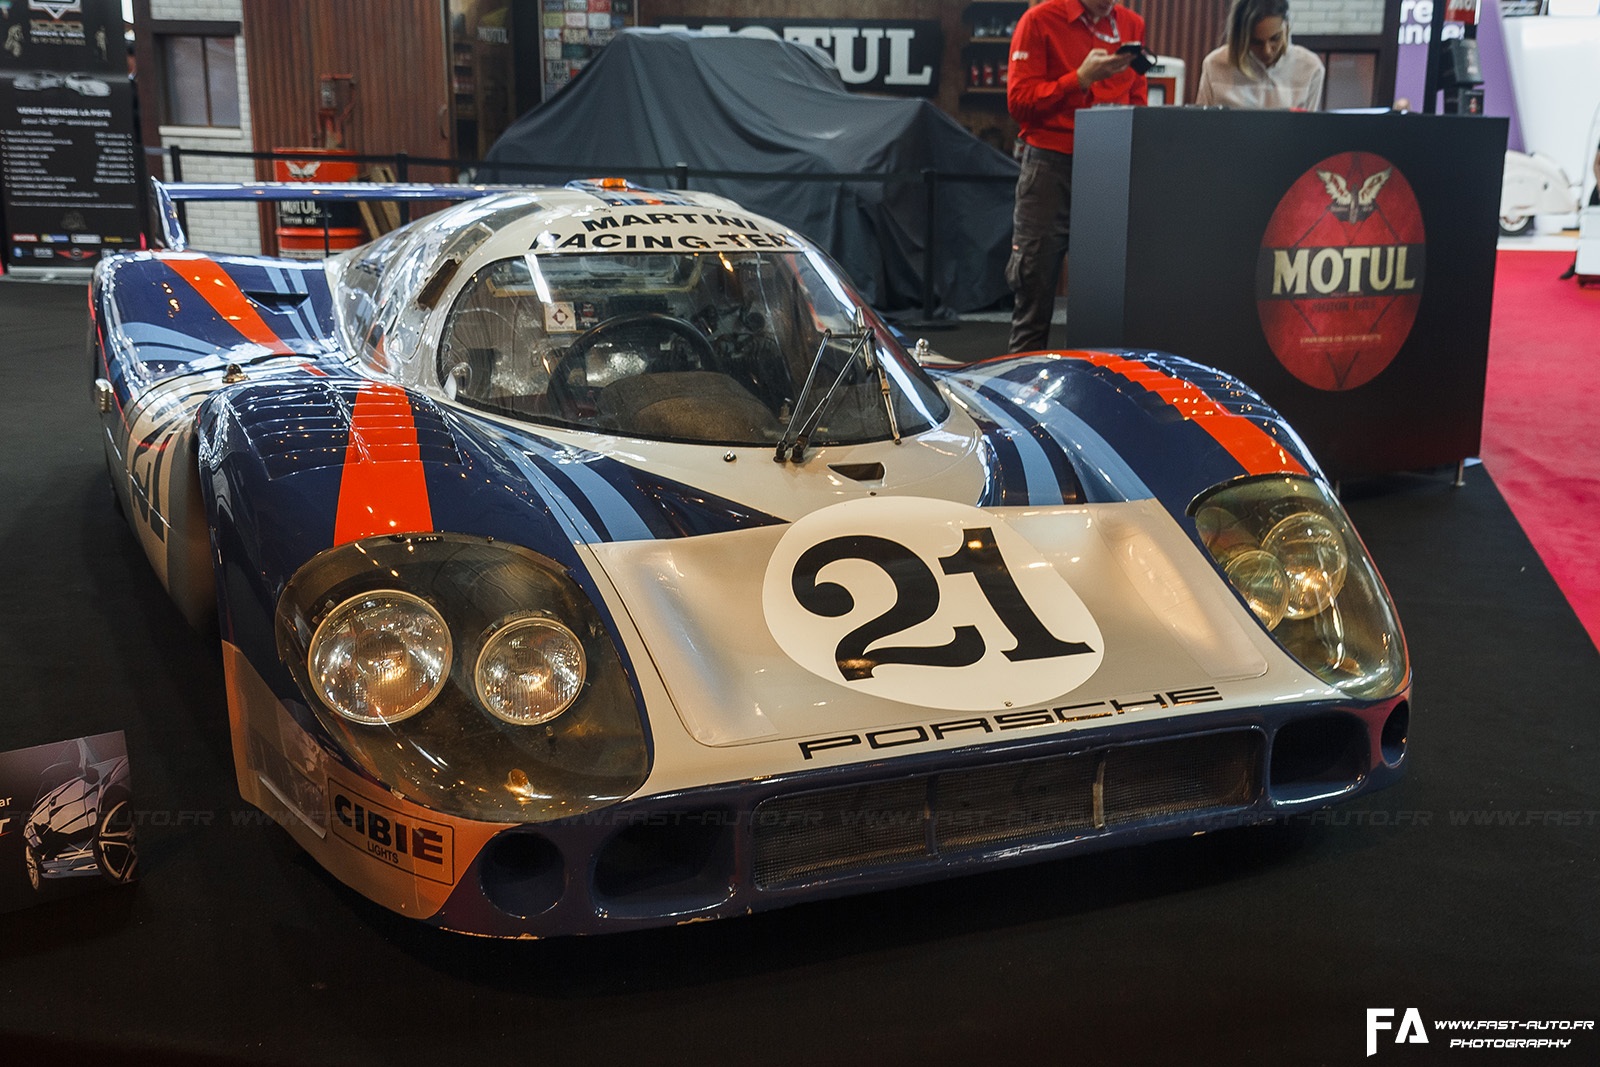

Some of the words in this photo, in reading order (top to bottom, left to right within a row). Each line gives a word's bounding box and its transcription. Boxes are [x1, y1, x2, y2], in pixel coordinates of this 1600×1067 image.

[581, 213, 759, 232] MARTINI
[1272, 247, 1416, 295] MOTUL
[791, 526, 1095, 682] 21
[798, 686, 1223, 760] PORSCHE
[367, 841, 399, 864] LIGHTS
